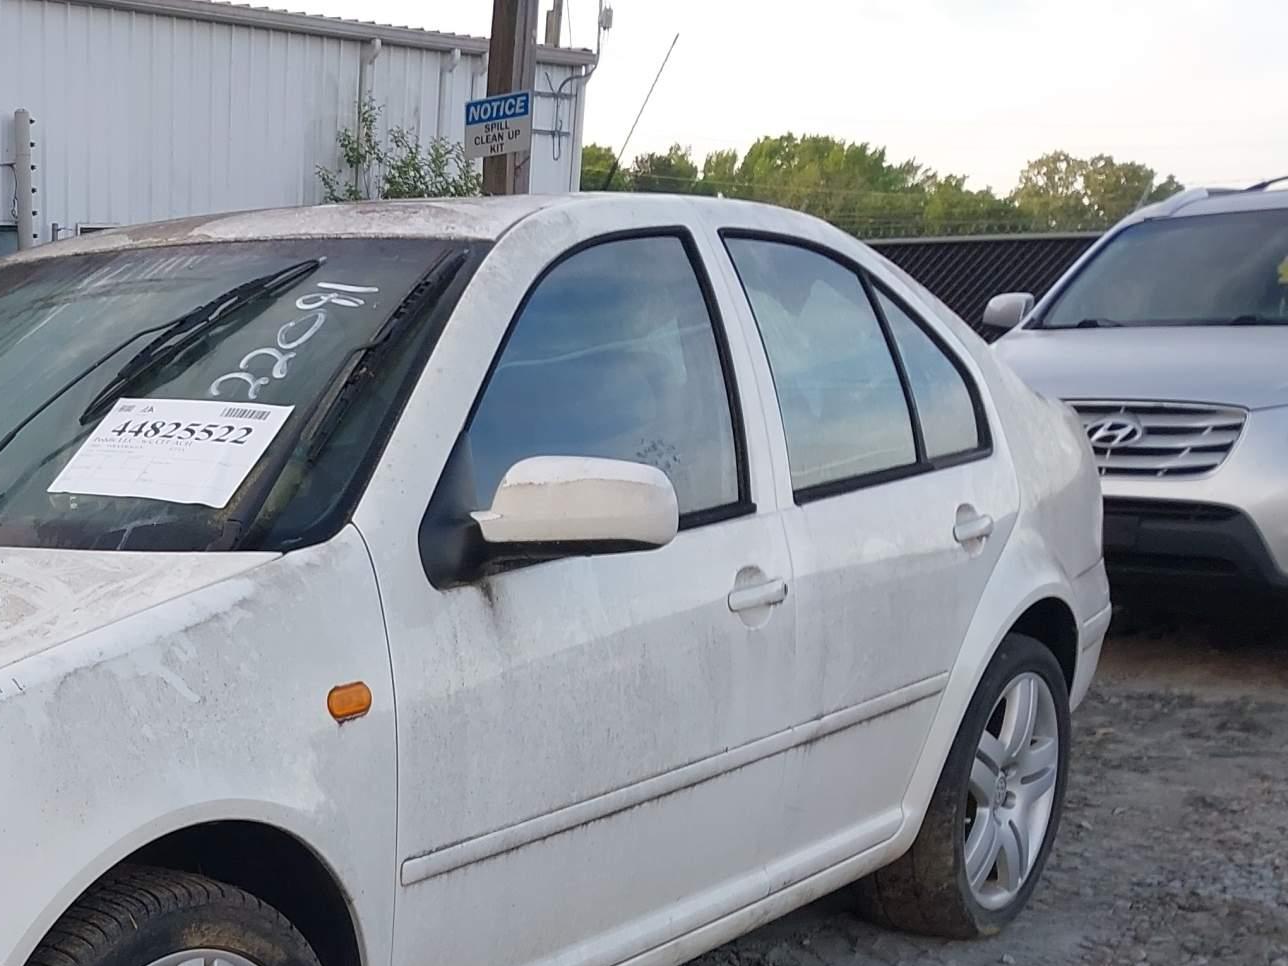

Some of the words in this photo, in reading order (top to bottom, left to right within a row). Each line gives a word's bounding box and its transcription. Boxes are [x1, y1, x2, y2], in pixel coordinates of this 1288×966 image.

[469, 96, 527, 122] NOTICE
[484, 120, 510, 133] SPILL
[474, 132, 505, 146] CLEAN
[507, 129, 521, 141] UP
[489, 143, 505, 154] KIT
[111, 419, 254, 446] 44825522
